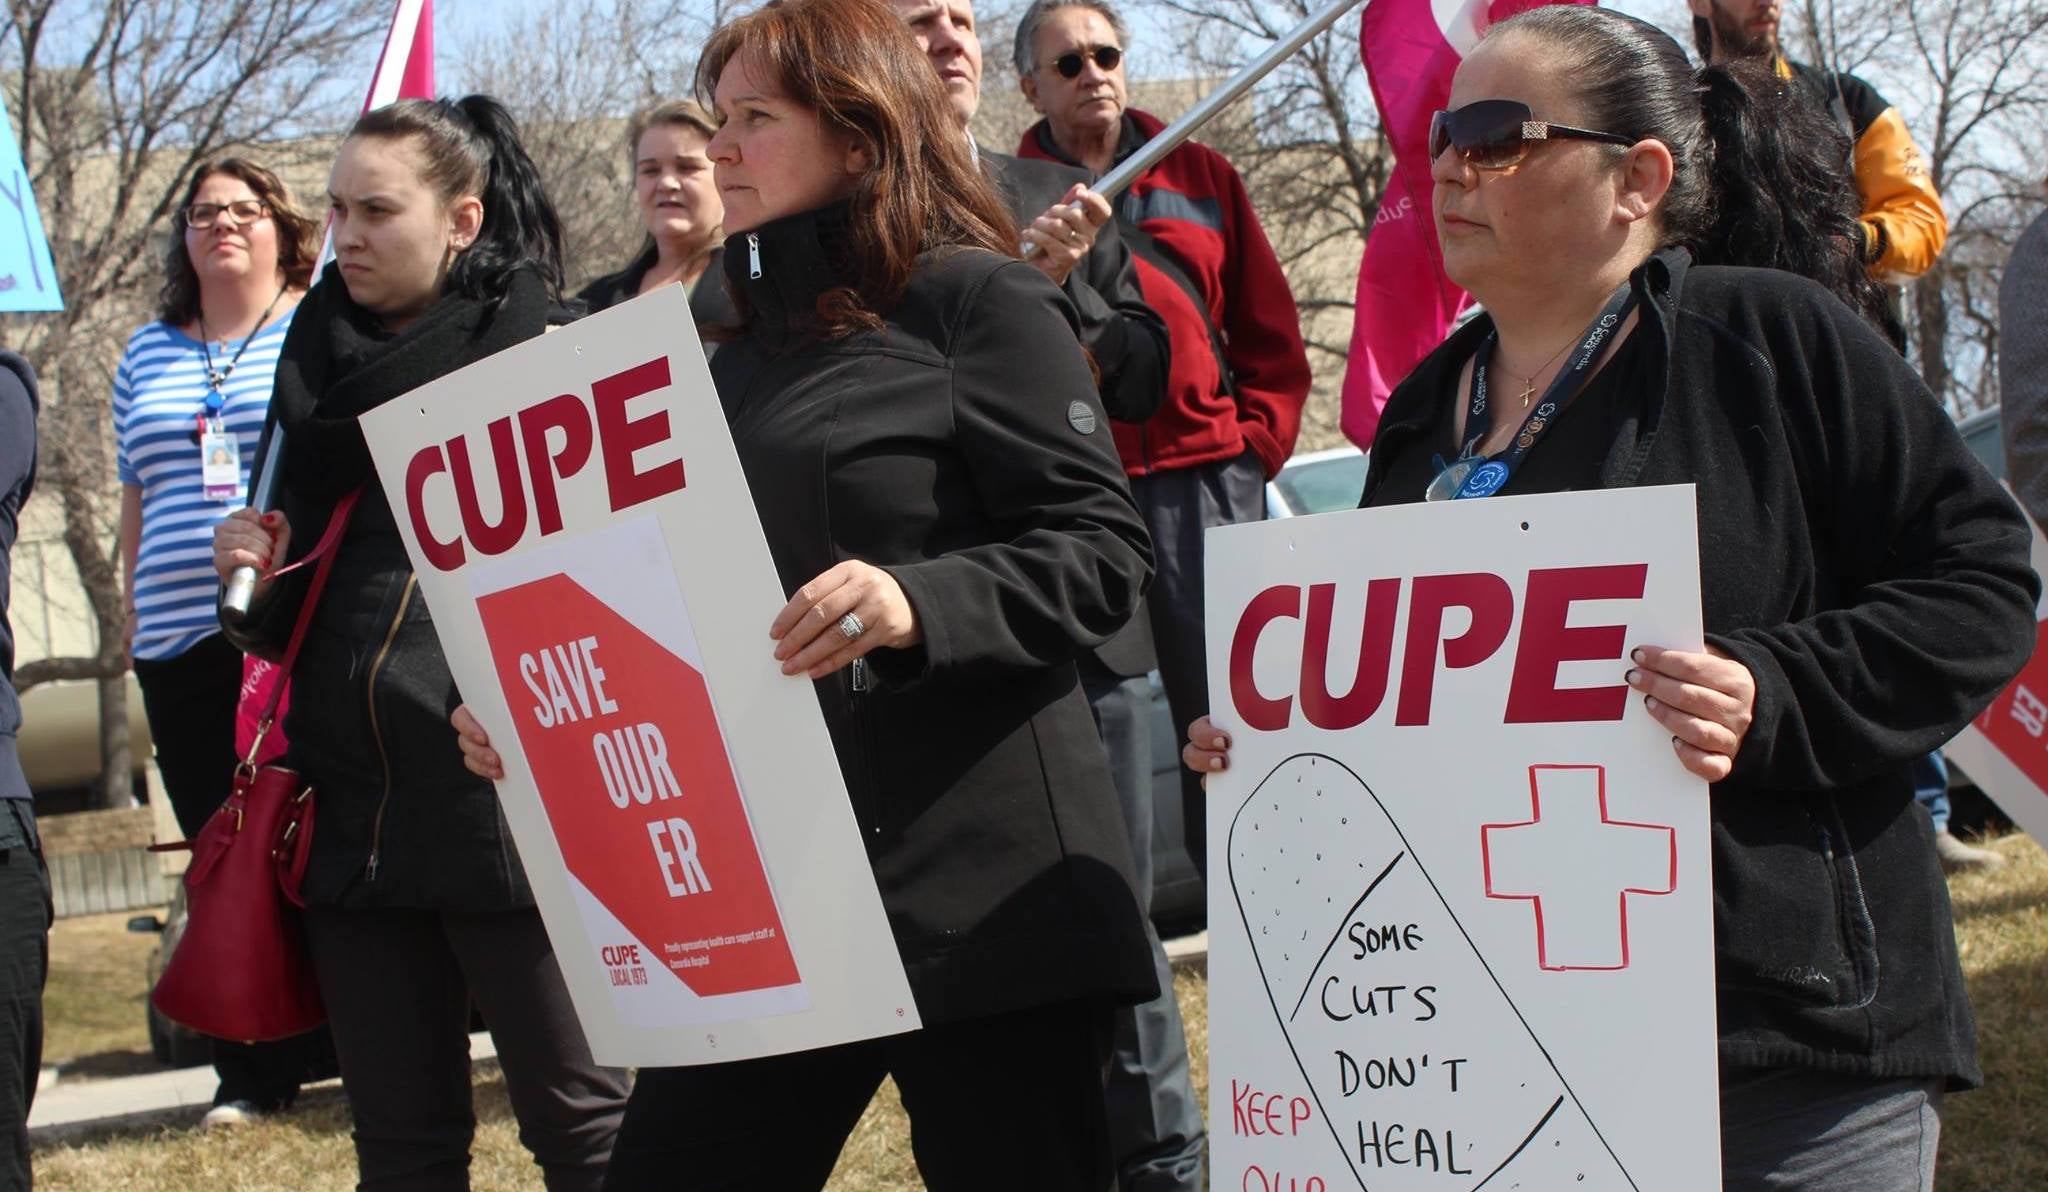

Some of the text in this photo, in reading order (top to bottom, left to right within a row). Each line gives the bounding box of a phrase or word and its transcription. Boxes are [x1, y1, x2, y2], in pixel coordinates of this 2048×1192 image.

[405, 355, 687, 572] CUPE
[1229, 563, 1649, 731] CUPE
[519, 636, 619, 728] SAVE
[592, 722, 683, 809] OUR
[646, 817, 713, 898] ER
[602, 945, 641, 967] CUPE
[1348, 921, 1424, 960] SOME
[609, 968, 632, 986] LOCAL
[1321, 976, 1437, 1022] CUTS
[1335, 1050, 1467, 1097] DON'T
[1232, 1079, 1311, 1137] KEEP
[1357, 1120, 1472, 1175] HEAL
